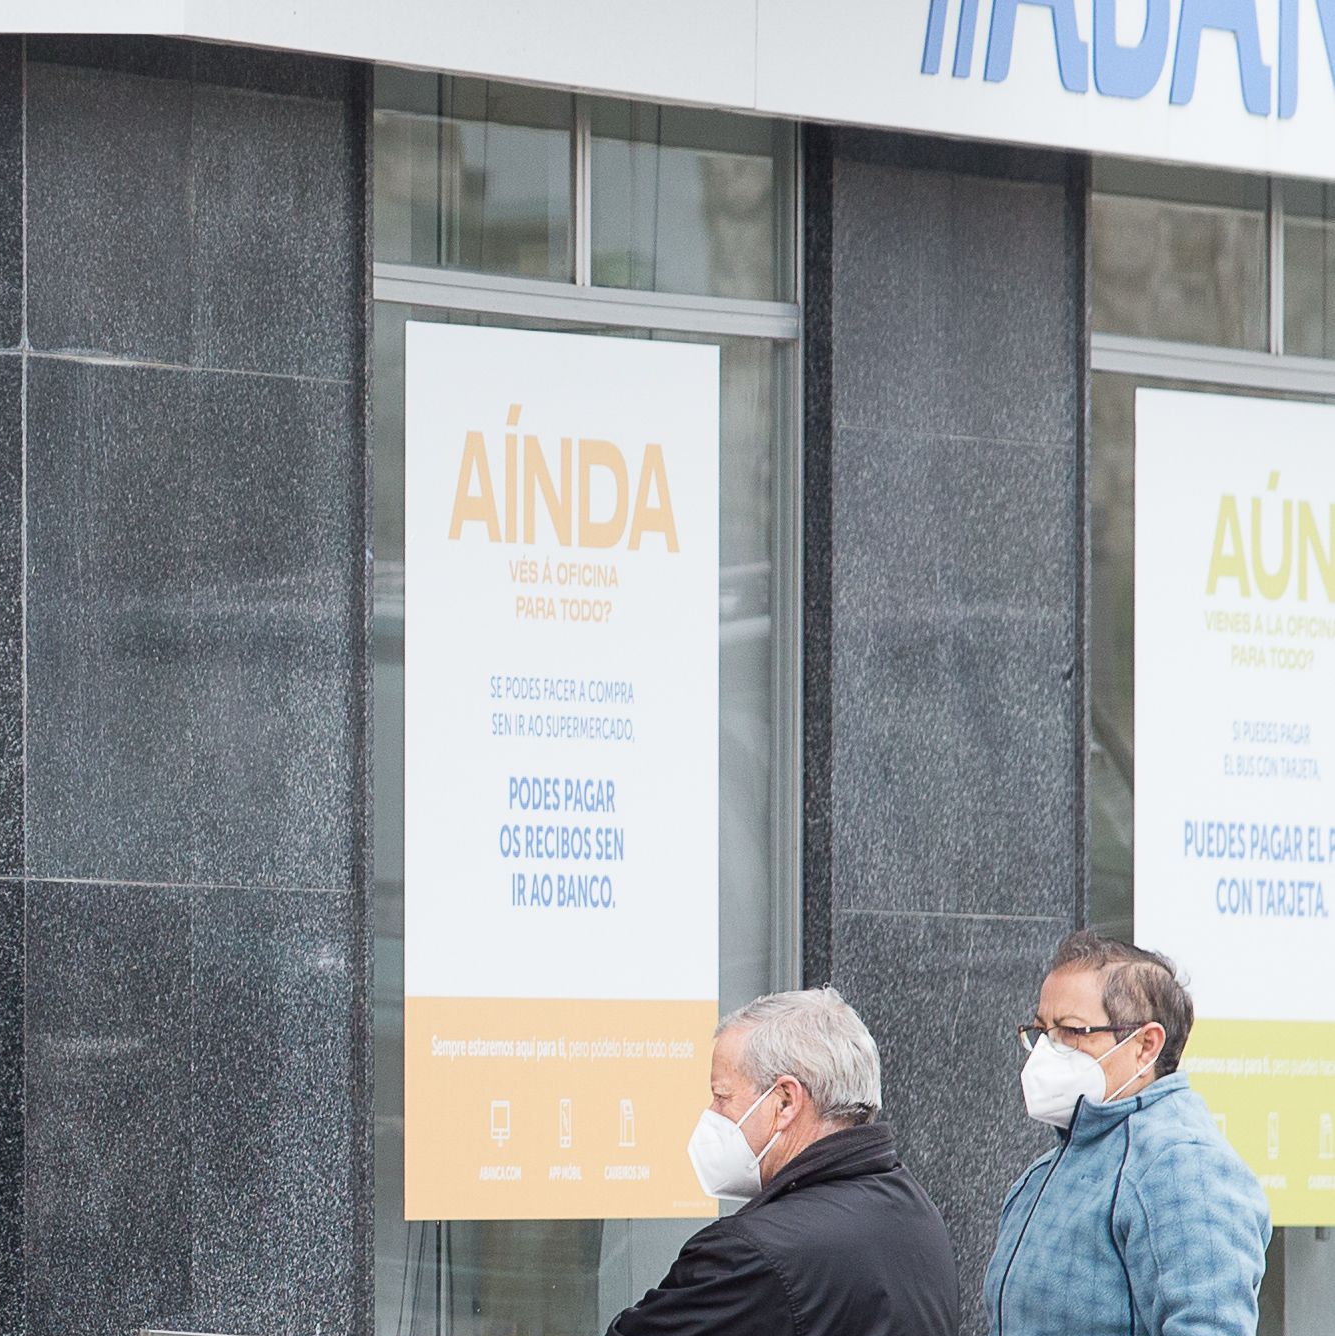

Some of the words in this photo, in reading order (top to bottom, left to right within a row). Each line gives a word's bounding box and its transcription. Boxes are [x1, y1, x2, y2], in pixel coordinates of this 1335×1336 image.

[448, 403, 680, 553] AÍNDA
[1205, 470, 1335, 604] AÚN
[509, 555, 538, 583] VÉS
[542, 556, 553, 584] Á
[557, 562, 618, 588] OFICINA
[516, 596, 556, 620] PARA
[560, 599, 612, 623] TODO?
[1204, 610, 1251, 634] VIENES
[1253, 613, 1263, 635] A
[1266, 613, 1283, 636] LA
[1232, 644, 1268, 668] PARA
[1270, 646, 1314, 670] TODO?
[490, 675, 502, 699] SE
[505, 676, 541, 701] PODES
[544, 678, 576, 702] FACER
[579, 680, 586, 702] A
[588, 680, 634, 704] COMPRA
[491, 712, 512, 737] SEN
[515, 714, 525, 737] IR
[528, 715, 543, 737] AO
[546, 716, 635, 743] SUPERMERCADO,
[1243, 721, 1278, 743] PUEDES
[1280, 721, 1311, 745] PAGAR
[510, 776, 560, 811] PODES
[565, 779, 615, 812] PAGAR
[499, 824, 521, 858] OS
[526, 825, 591, 860] RECIBOS
[596, 827, 624, 861] SEN
[1184, 820, 1245, 860] PUEDES
[1250, 824, 1303, 862] PAGAR
[1308, 826, 1325, 863] EL
[512, 873, 526, 907] IR
[530, 873, 553, 907] AO
[558, 874, 615, 909] BANCO.
[1216, 877, 1252, 916] CON
[1257, 879, 1329, 918] TARJETA.
[432, 1035, 466, 1061] Sempre
[468, 1037, 513, 1057] estaremos
[537, 1040, 558, 1062] para
